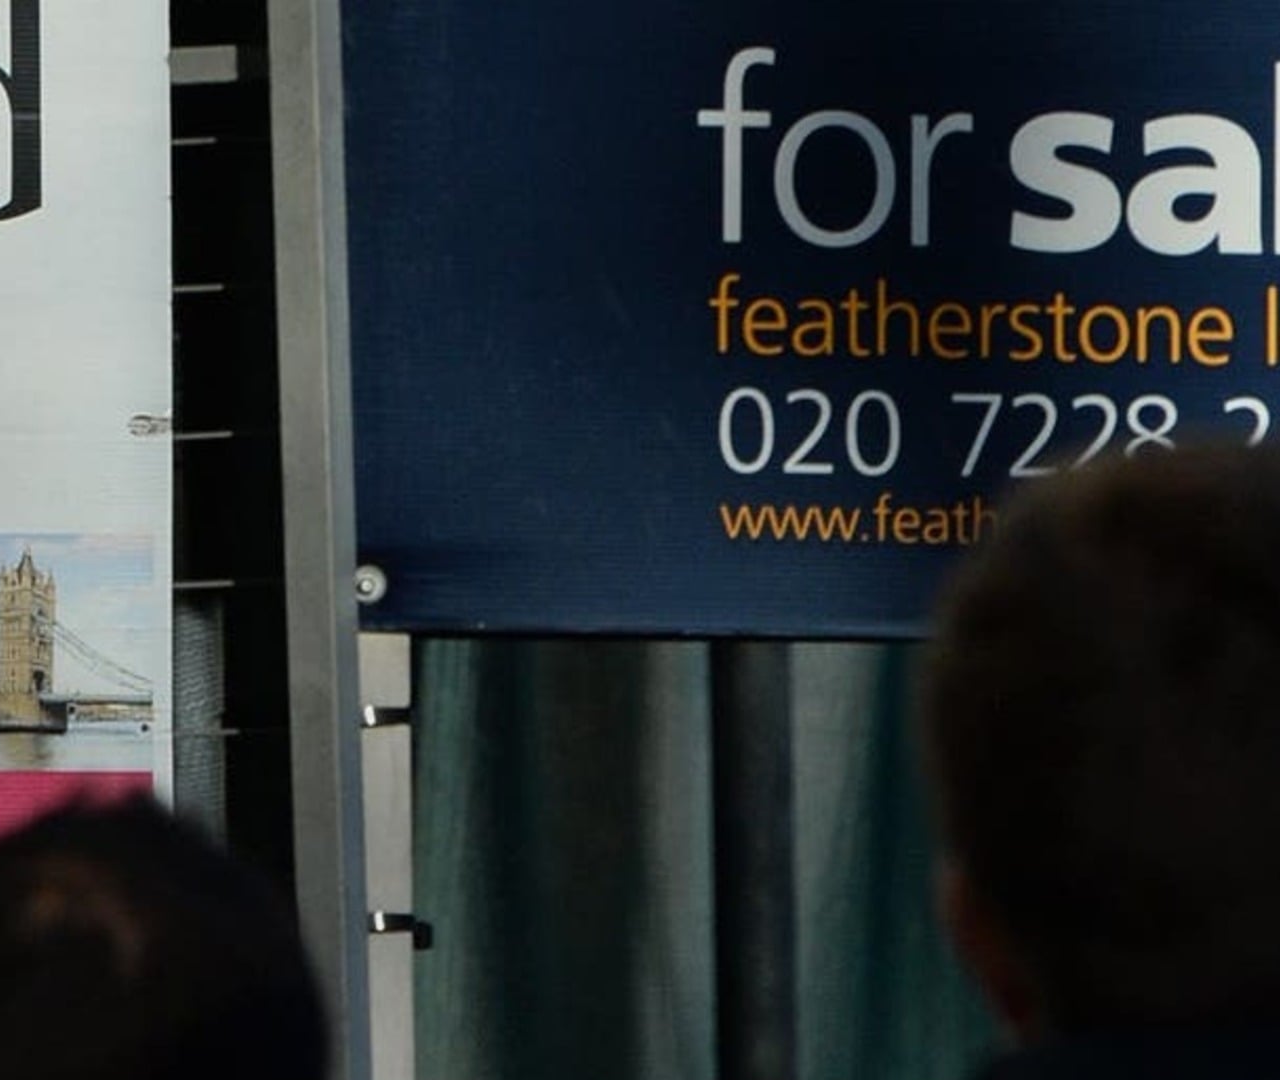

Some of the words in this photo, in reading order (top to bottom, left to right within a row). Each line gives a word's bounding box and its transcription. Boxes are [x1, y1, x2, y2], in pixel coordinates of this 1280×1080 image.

[696, 46, 974, 248] for
[709, 273, 1234, 367] featherstone
[718, 386, 901, 477] 020
[951, 392, 1179, 478] 7228
